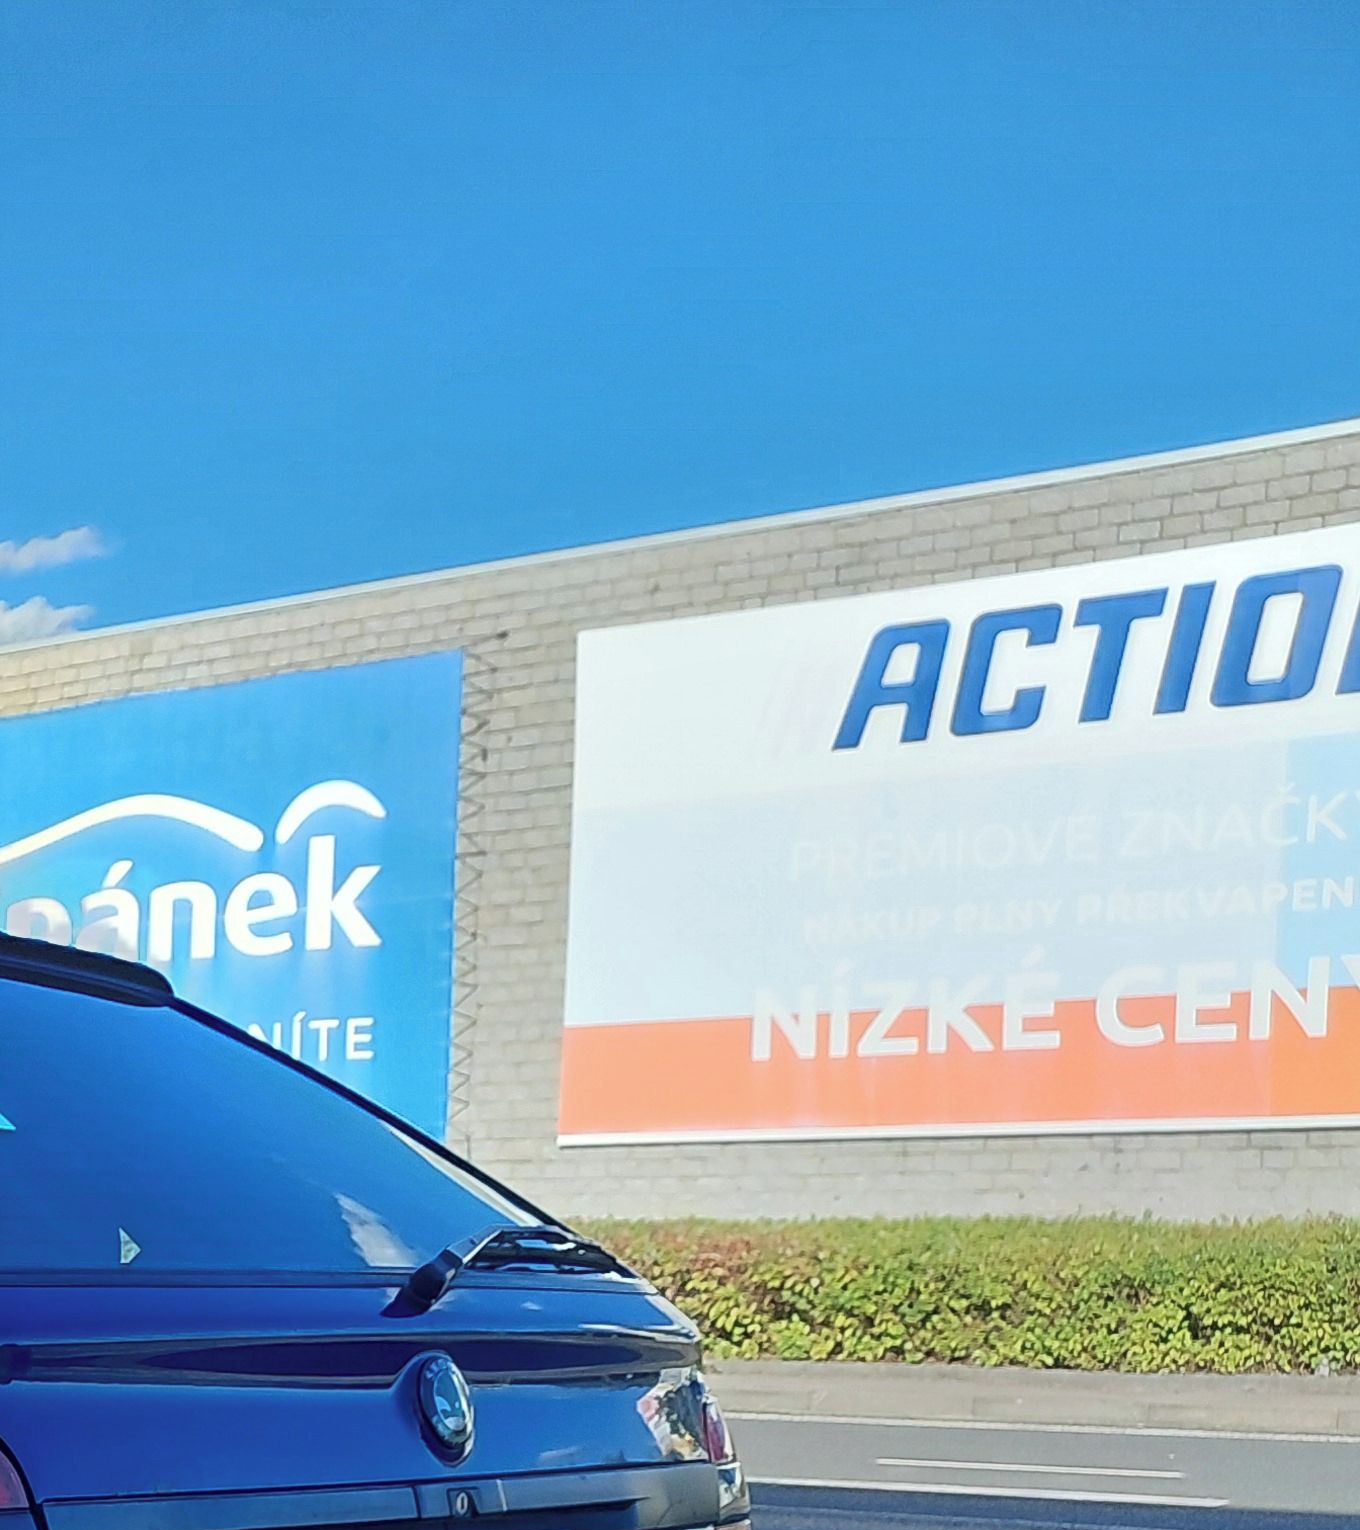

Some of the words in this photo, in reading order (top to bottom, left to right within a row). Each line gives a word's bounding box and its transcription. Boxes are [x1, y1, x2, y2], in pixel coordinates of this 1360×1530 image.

[832, 564, 1360, 751] ACTIO
[1120, 782, 1360, 858] ZNAČK
[751, 944, 1061, 1060] NÍZKÉ
[1095, 953, 1360, 1047] CEN
